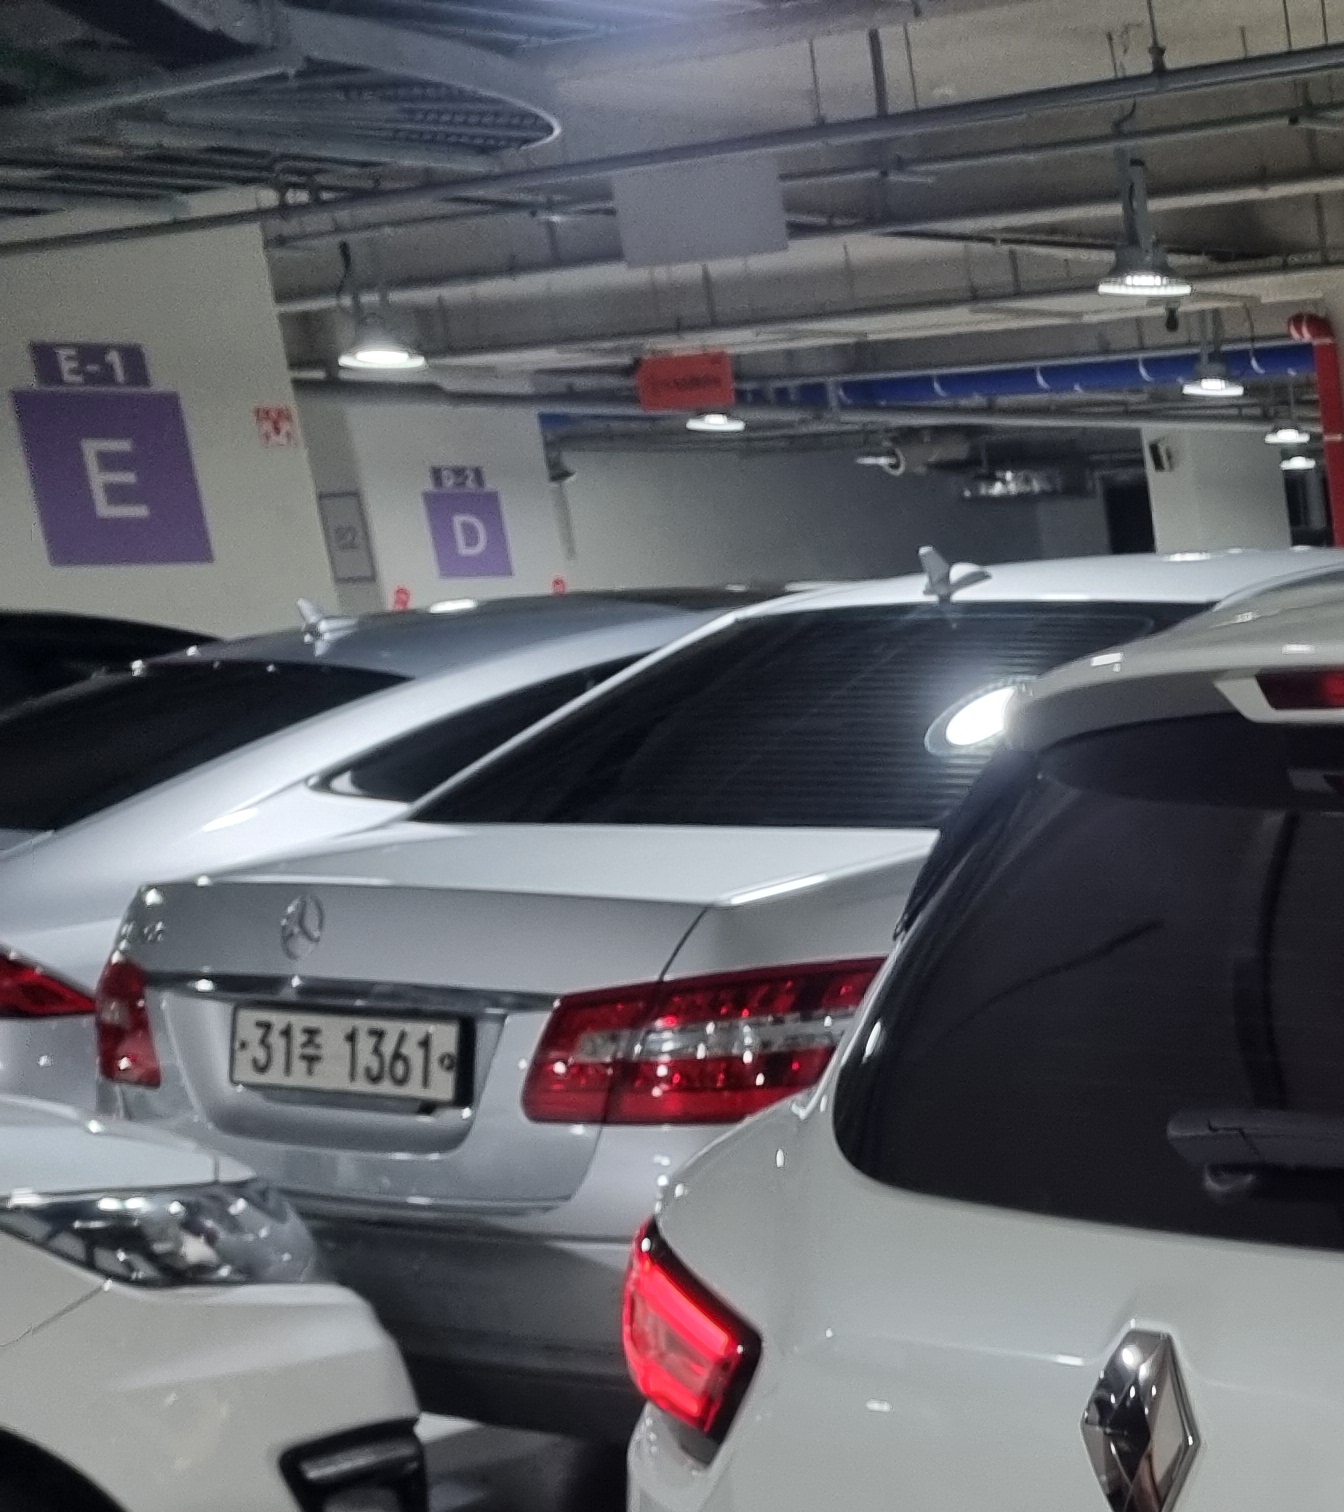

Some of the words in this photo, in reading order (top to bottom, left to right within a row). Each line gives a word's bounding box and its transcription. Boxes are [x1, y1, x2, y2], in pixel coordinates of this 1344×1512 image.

[54, 347, 126, 384] E-1
[80, 436, 150, 520] E
[452, 514, 488, 557] D
[252, 1019, 323, 1078] 31주
[344, 1025, 432, 1090] 1361
